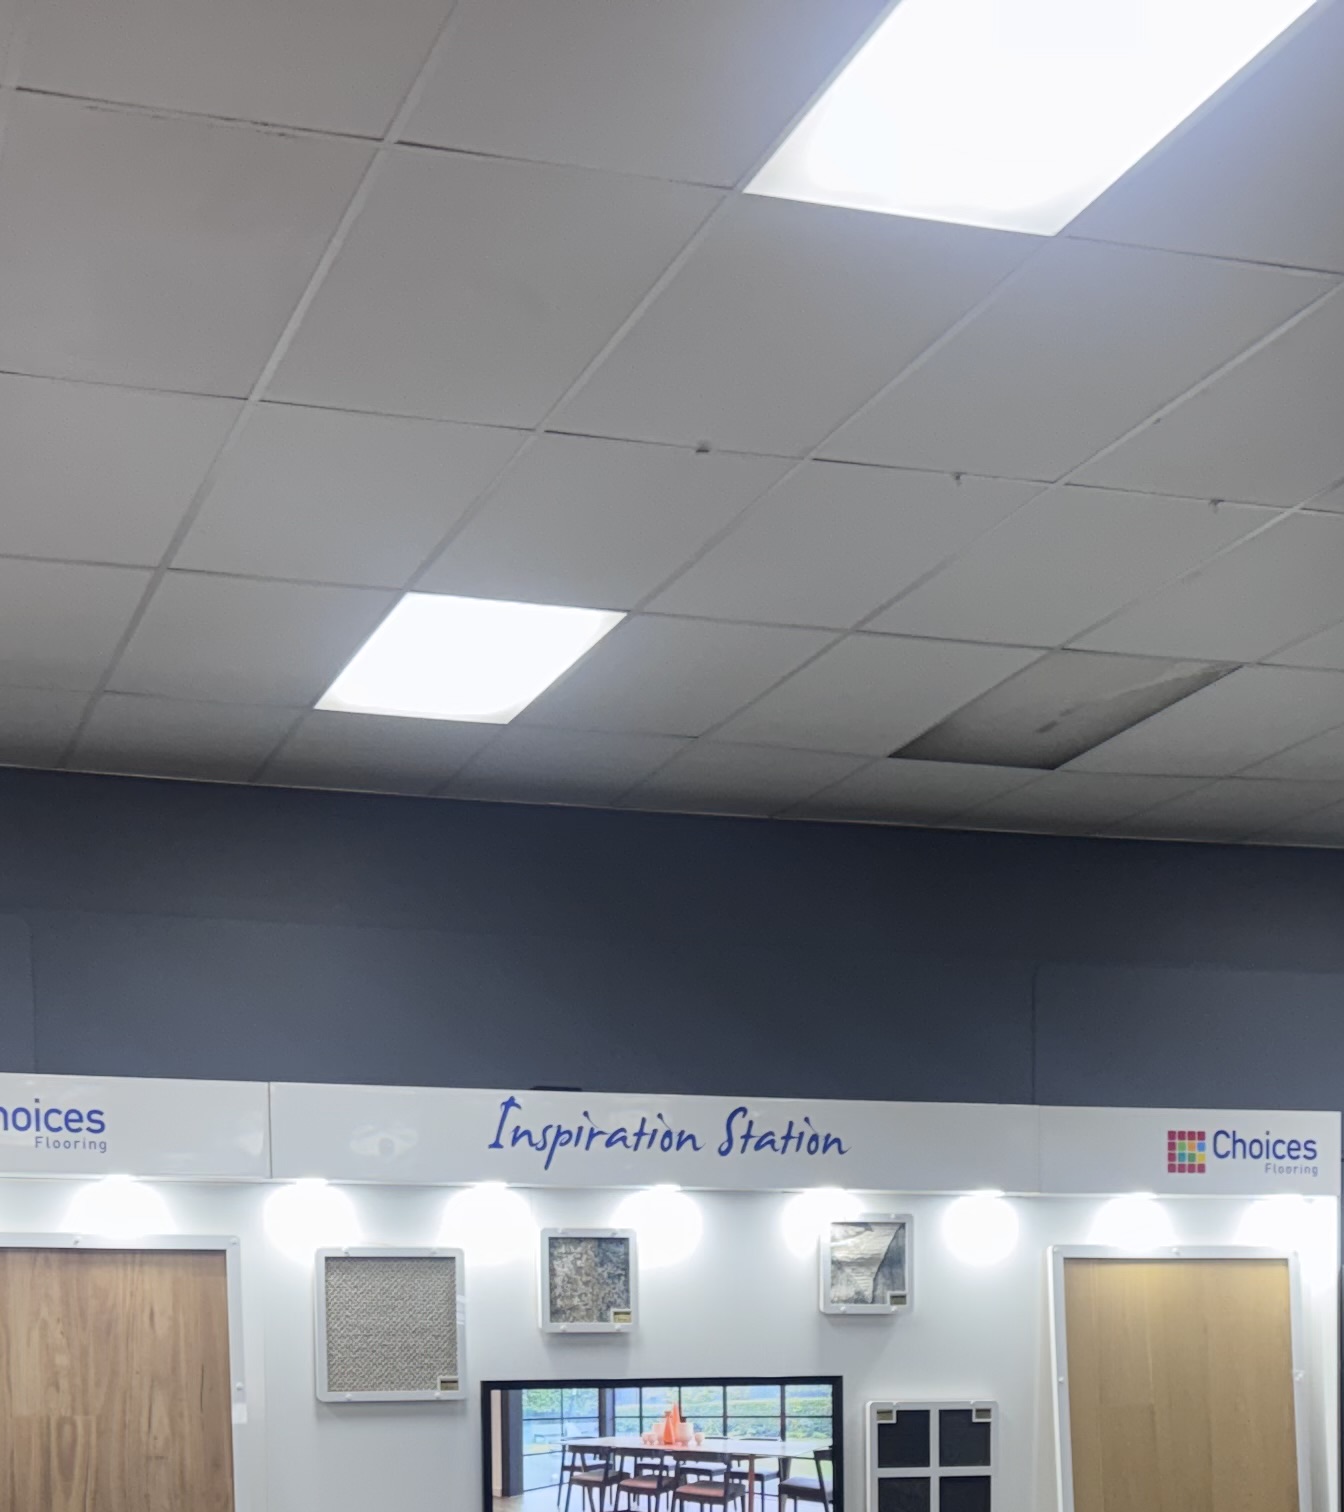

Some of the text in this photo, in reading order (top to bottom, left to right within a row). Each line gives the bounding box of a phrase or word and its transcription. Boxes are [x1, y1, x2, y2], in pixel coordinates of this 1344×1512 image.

[34, 1135, 107, 1154] Flooring
[488, 1095, 852, 1171] Inspiration Station
[1212, 1129, 1318, 1161] Choices
[1264, 1162, 1319, 1177] Flooring
